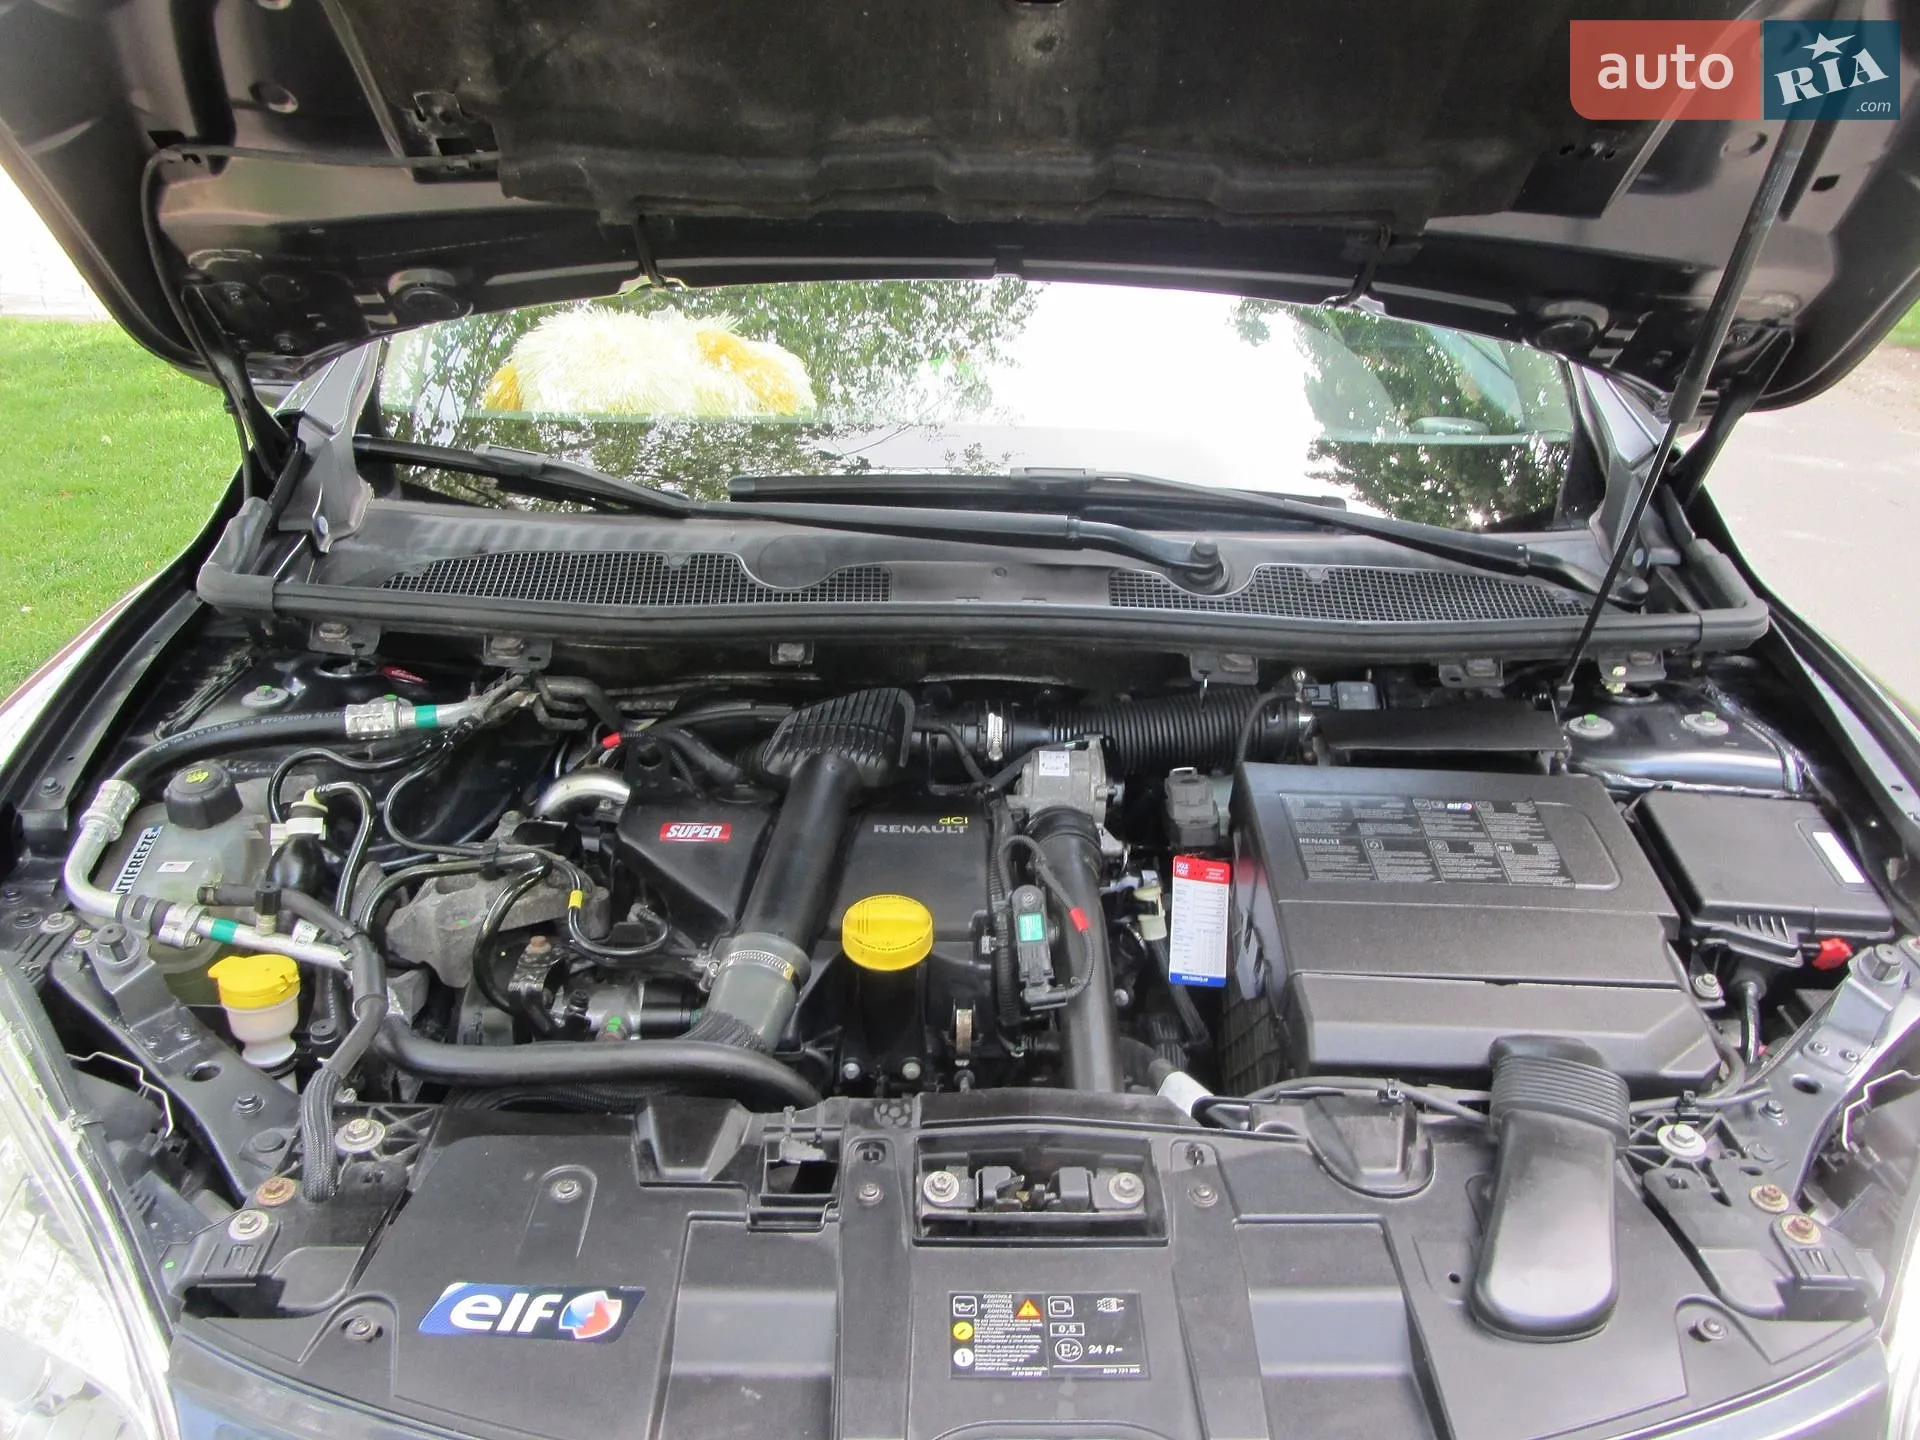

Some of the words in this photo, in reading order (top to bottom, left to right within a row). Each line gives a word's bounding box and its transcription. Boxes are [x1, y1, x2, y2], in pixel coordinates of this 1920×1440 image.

[665, 824, 723, 839] SUPER
[873, 824, 968, 833] RENAULT
[1299, 837, 1340, 845] RENAULT
[450, 1293, 563, 1332] elf
